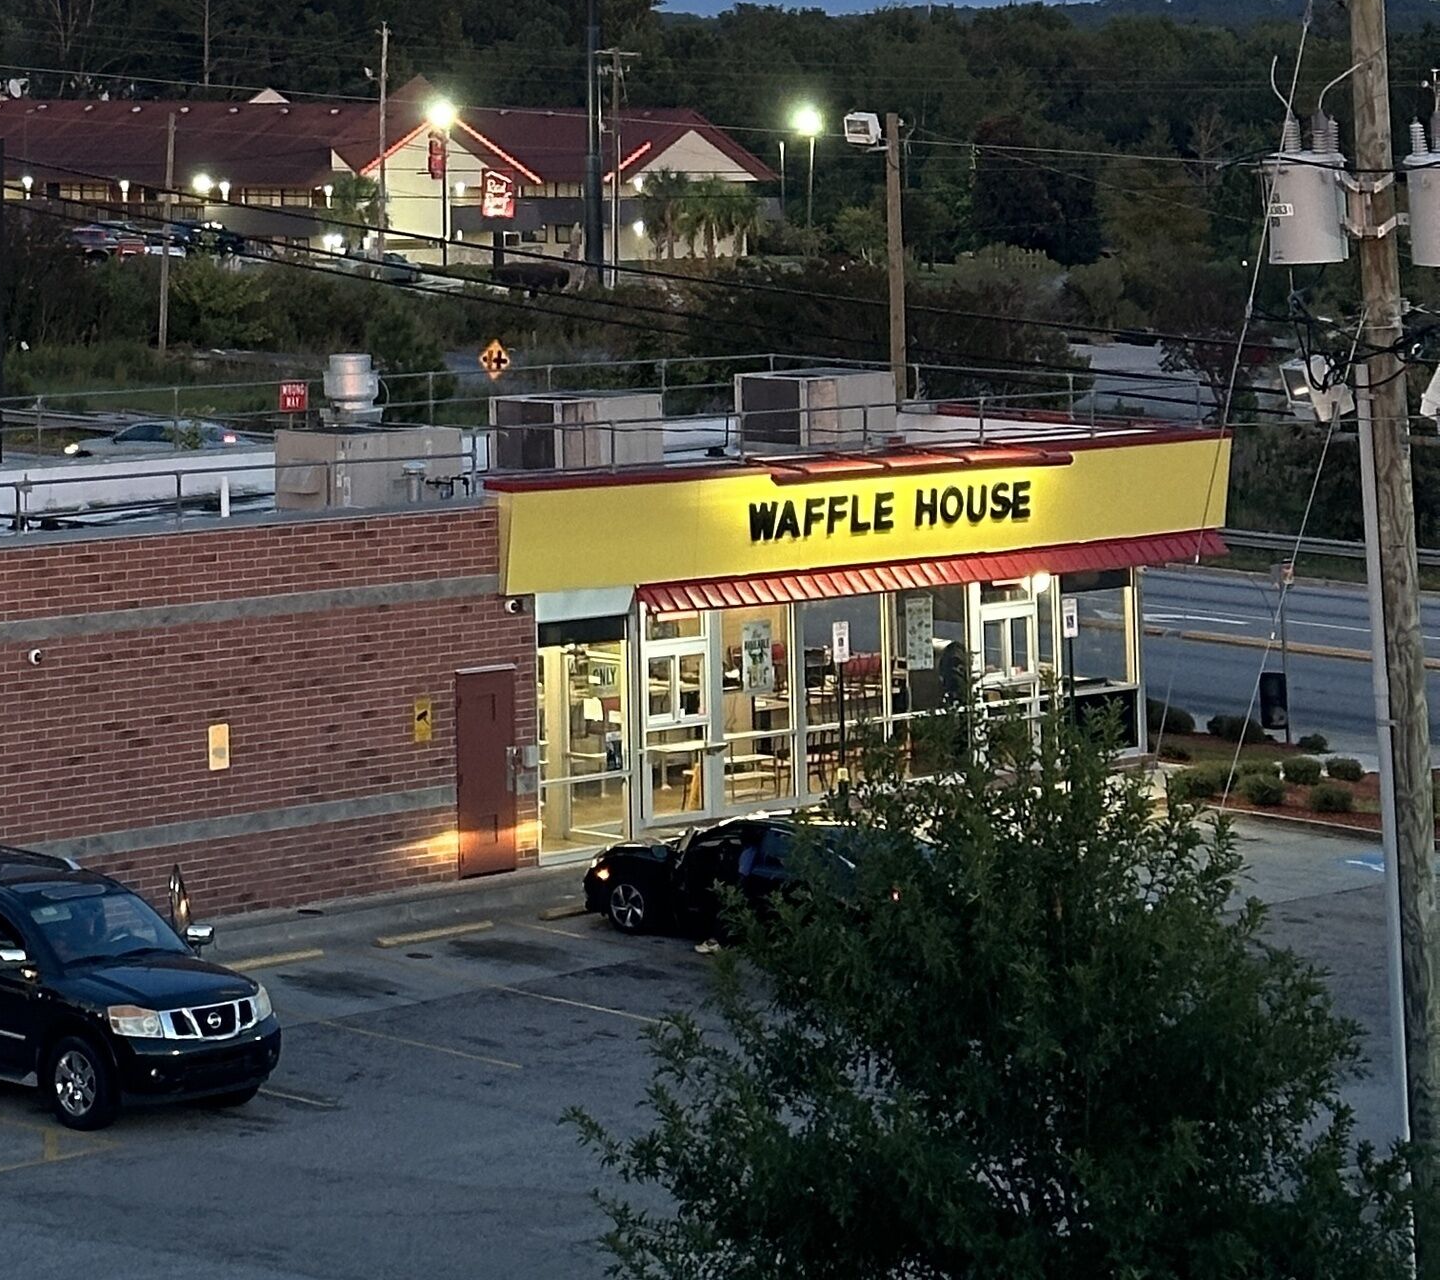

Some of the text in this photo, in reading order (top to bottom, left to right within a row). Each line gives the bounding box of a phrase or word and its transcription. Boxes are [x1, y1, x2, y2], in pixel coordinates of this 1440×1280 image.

[282, 383, 305, 396] WRONG
[748, 480, 1032, 542] WAFFLE HOUSE
